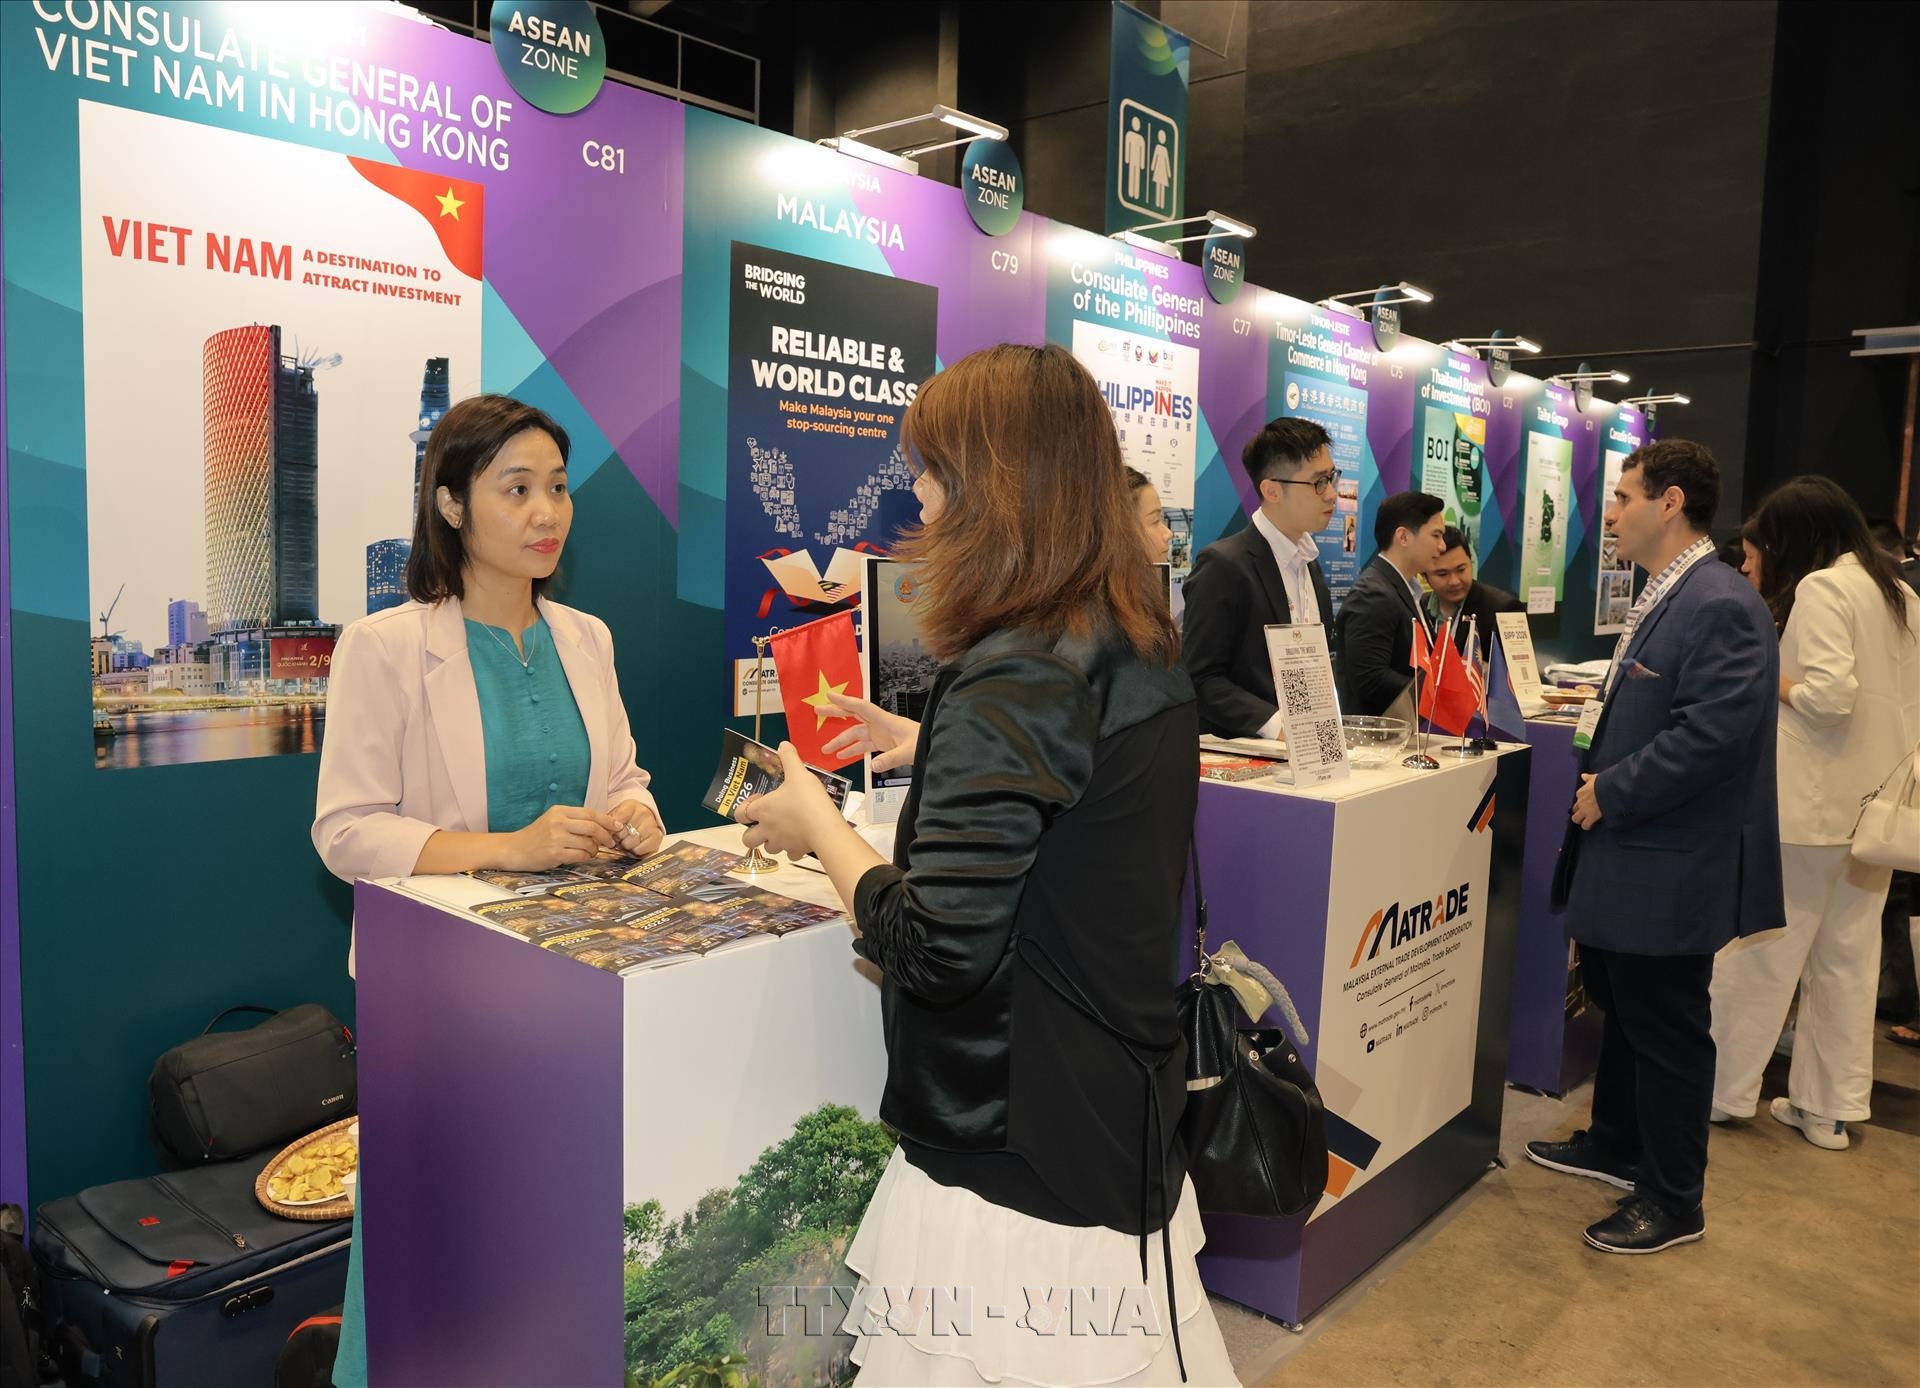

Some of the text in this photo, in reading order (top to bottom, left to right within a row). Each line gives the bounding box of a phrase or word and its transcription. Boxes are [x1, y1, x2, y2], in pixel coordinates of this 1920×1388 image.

[508, 10, 591, 57] ASEAN
[31, 0, 513, 132] CONSULATE GENERAL OF
[521, 43, 579, 79] ZONE
[35, 27, 510, 171] VIET NAM IN HONG KONG
[582, 140, 625, 174] C81
[971, 163, 1016, 193] ASEAN
[977, 186, 1009, 210] ZONE
[776, 193, 905, 251] MALAYSIA
[102, 215, 293, 281] VIET NAM
[991, 250, 1019, 275] C79
[1209, 246, 1241, 270] ASEAN
[302, 249, 442, 282] A DESTINATION TO
[744, 264, 806, 290] BRIDGING
[1113, 252, 1169, 280] PHILIPPINES
[1213, 264, 1235, 283] ZONE
[302, 271, 462, 306] ATTRACT INVESTMENT
[744, 281, 806, 305] THE WORLD
[1071, 262, 1204, 318] Consulate General
[1073, 289, 1201, 340] of the Philippines
[1232, 318, 1251, 337] C77
[1376, 305, 1398, 321] ASEAN
[1379, 320, 1394, 335] ZONE
[771, 325, 905, 373] RELIABLE &
[1276, 320, 1317, 350] Timor-Leste
[1317, 333, 1343, 359] General
[1287, 346, 1367, 385] Commerce in Hong Kong
[1431, 367, 1485, 397] Thailand Board
[751, 359, 919, 408] WORLD CLASS
[1097, 380, 1193, 420] HILIPPINES
[1421, 383, 1491, 416] of Investment (BOI)
[779, 399, 895, 425] Make Malaysia your one
[786, 419, 888, 438] stop-sourcing centre
[1427, 436, 1449, 462] BOI
[309, 653, 331, 669] 2/9
[714, 756, 738, 803] Doing Business
[727, 780, 741, 797] Viet
[736, 760, 747, 779] Nam
[1349, 882, 1470, 969] MATRADE
[1342, 920, 1473, 992] MALAYSIA EXTERNAL TRADE DEVELOPMENT CORPORATION
[1356, 982, 1383, 1002] Consulate
[1383, 972, 1404, 989] General
[321, 1093, 345, 1106] Canon
